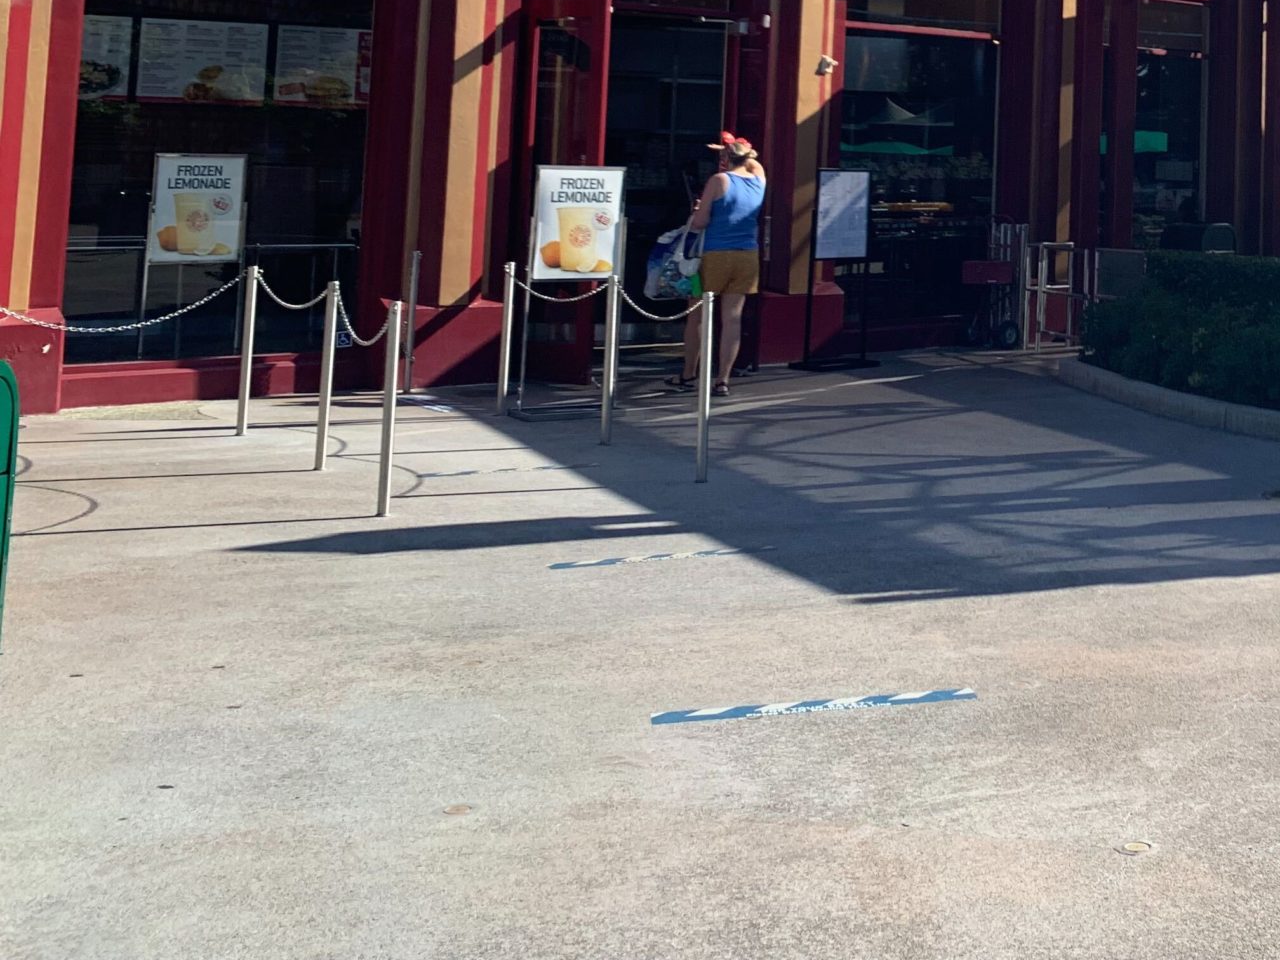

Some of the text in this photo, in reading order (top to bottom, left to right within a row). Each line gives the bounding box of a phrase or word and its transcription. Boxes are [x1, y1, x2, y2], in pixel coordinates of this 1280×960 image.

[177, 164, 223, 177] FROZEN
[167, 178, 231, 190] LEMONADE
[560, 178, 605, 190] FROZEN
[550, 191, 613, 203] LEMONADE
